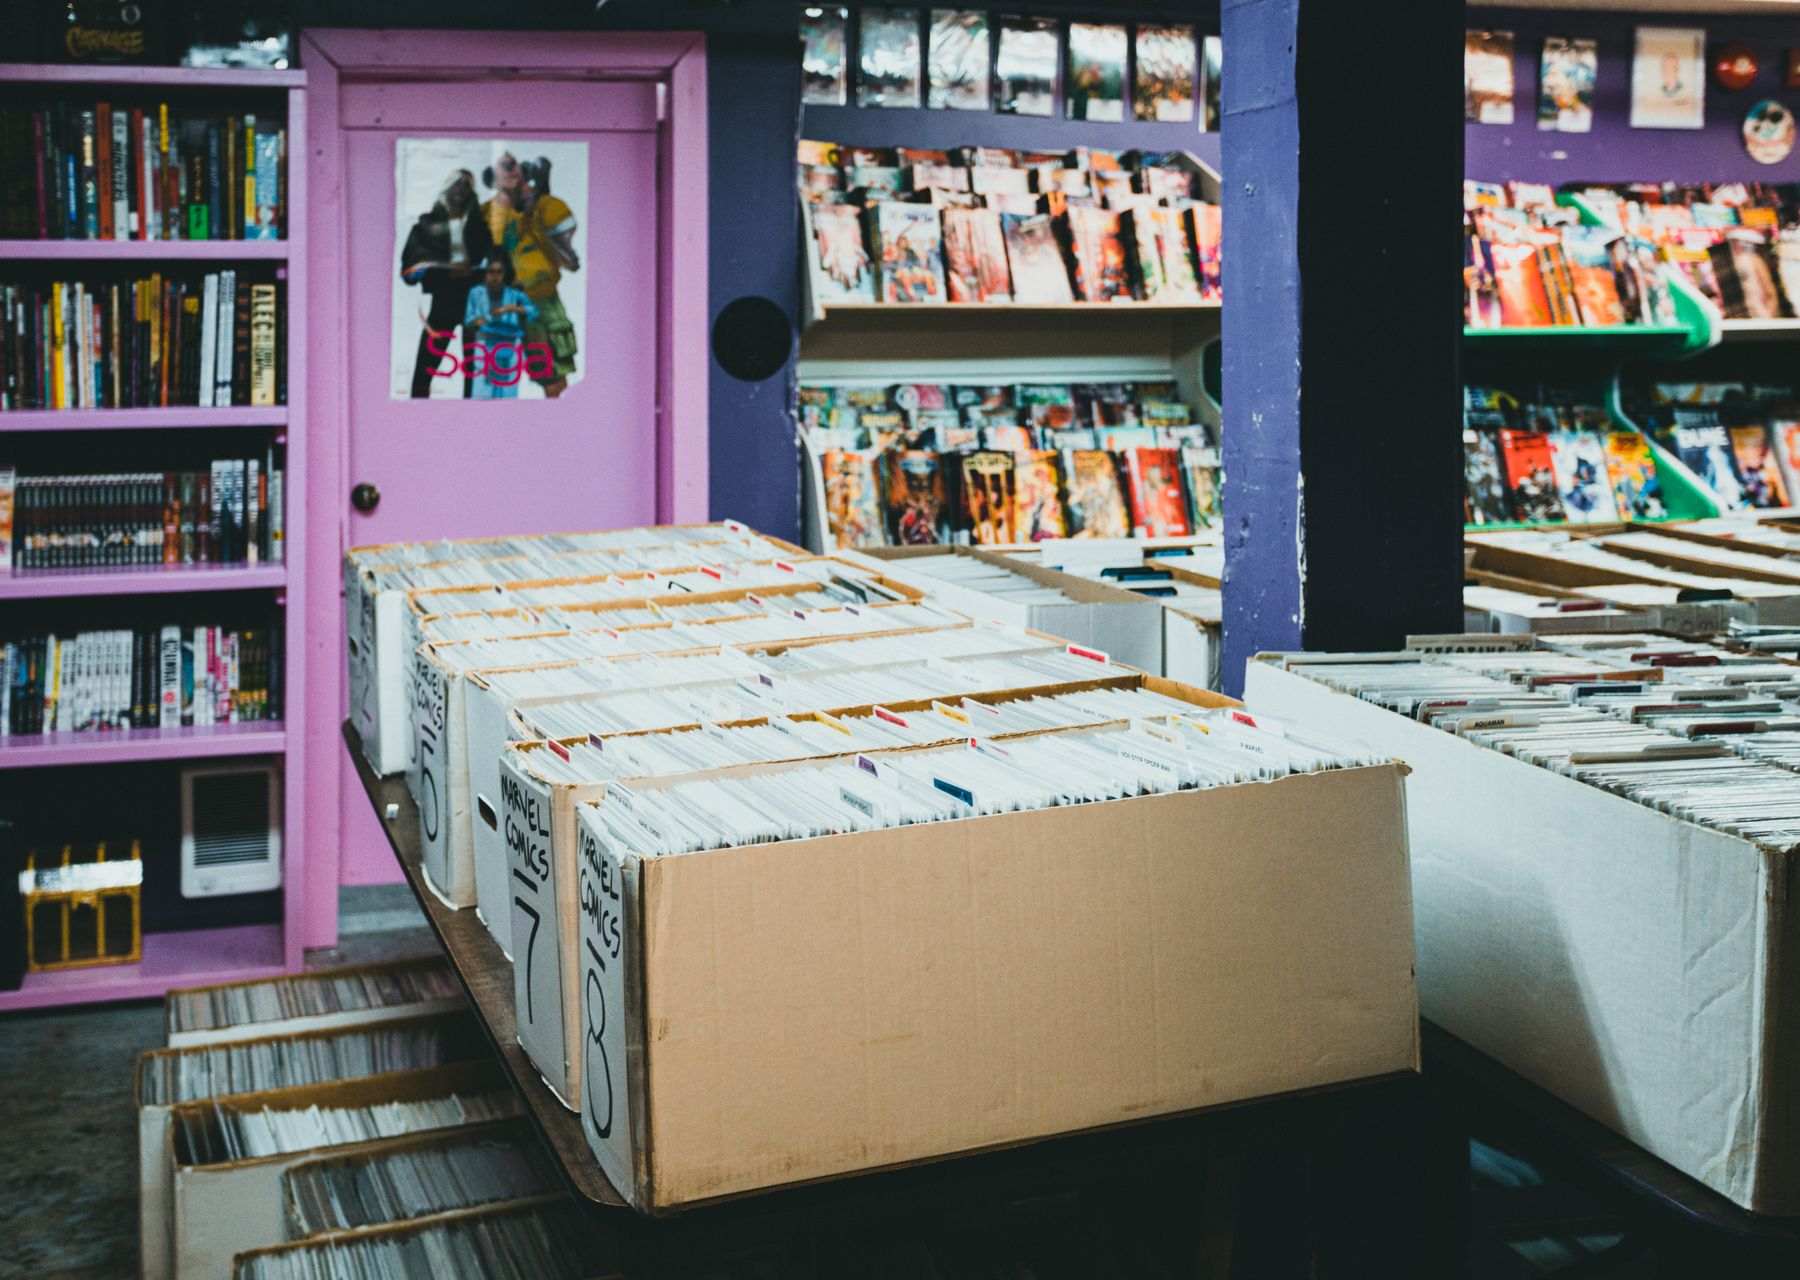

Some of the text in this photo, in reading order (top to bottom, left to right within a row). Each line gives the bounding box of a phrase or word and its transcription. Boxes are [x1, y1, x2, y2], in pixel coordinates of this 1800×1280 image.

[255, 289, 273, 331] ALEC
[1474, 718, 1505, 729] AQUAMAN
[501, 774, 549, 838] MARVEL
[505, 814, 550, 882] COMICS
[579, 827, 620, 901] MARVEL
[580, 868, 621, 959] COMICS
[514, 895, 541, 1024] 7
[586, 967, 613, 1139] 8
